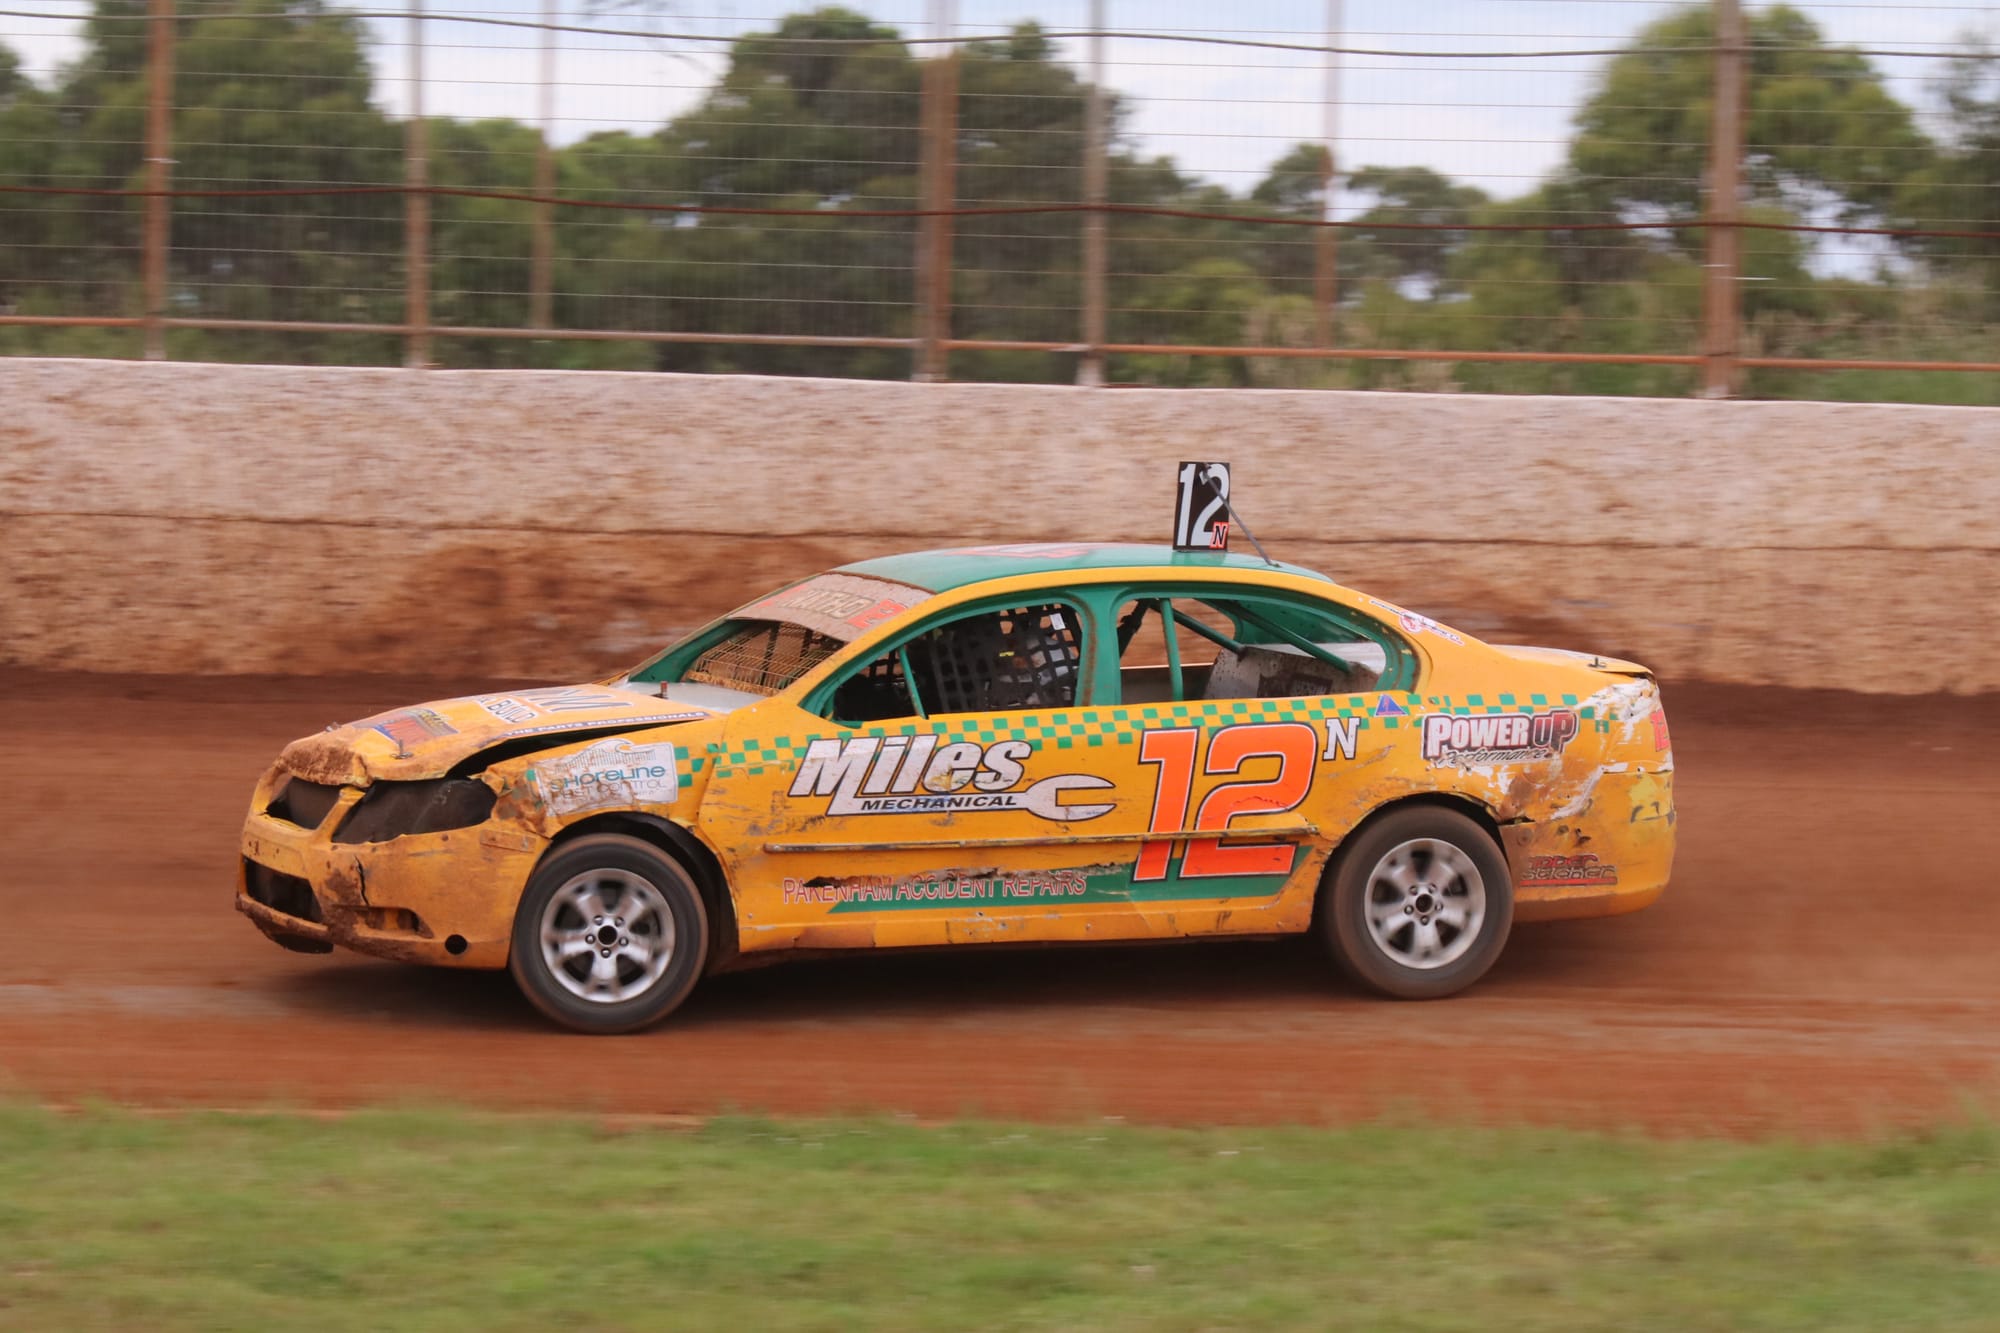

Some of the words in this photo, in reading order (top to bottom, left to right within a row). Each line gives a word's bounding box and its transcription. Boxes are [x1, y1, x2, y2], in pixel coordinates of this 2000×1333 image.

[1177, 463, 1229, 546] 12
[1211, 523, 1228, 547] N
[505, 727, 533, 736] THE
[537, 721, 583, 732] PARTS
[587, 711, 705, 726] PROFESSIONALS
[1425, 715, 1531, 757] POWER
[1533, 711, 1577, 754] UP
[787, 734, 1033, 798] Miles
[860, 795, 1018, 811] MECHANICAL
[1131, 721, 1318, 883] 12
[1322, 717, 1361, 760] N
[895, 871, 994, 902] ACCIDENT
[1002, 870, 1088, 898] REPAIRS
